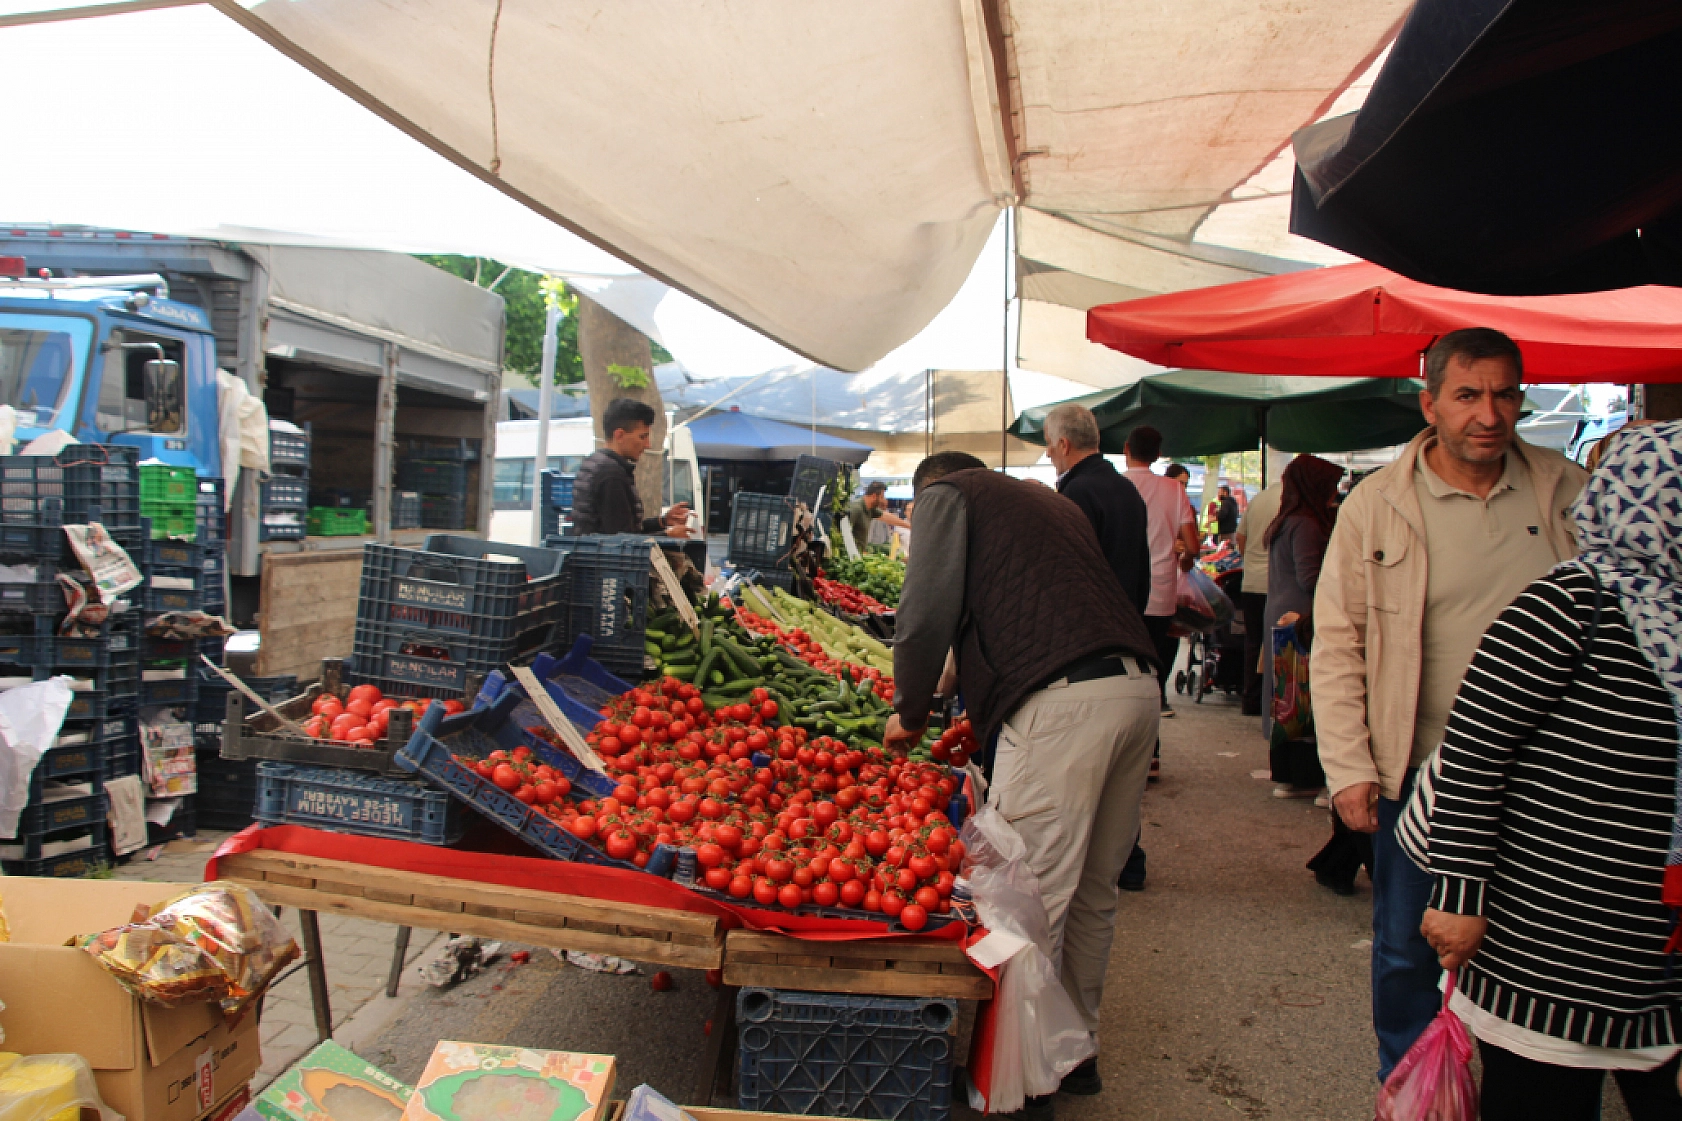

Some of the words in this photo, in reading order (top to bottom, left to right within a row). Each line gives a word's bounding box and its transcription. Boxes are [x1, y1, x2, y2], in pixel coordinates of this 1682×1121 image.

[298, 800, 343, 818] TARIM
[351, 808, 403, 826] HEDEF
[364, 1067, 403, 1091] BEST
